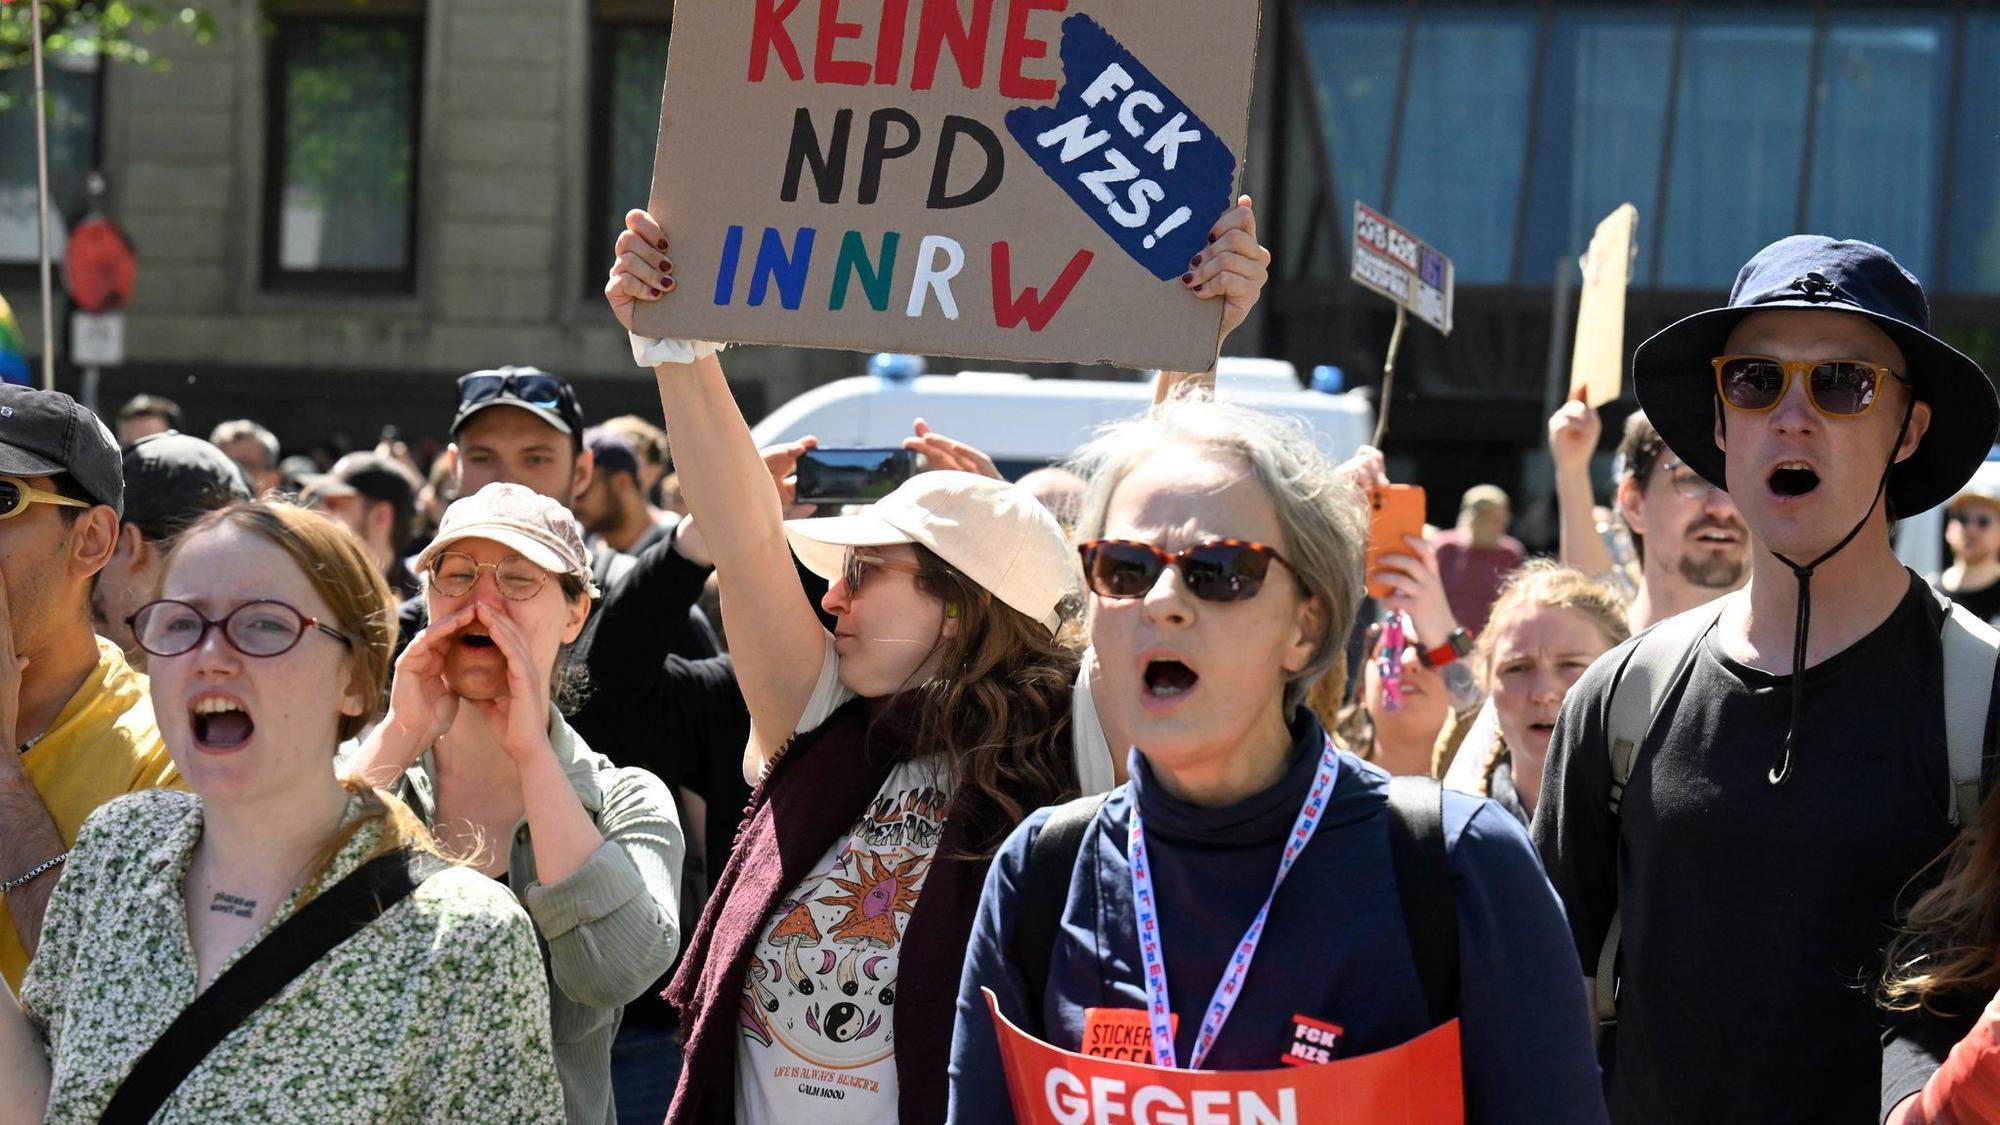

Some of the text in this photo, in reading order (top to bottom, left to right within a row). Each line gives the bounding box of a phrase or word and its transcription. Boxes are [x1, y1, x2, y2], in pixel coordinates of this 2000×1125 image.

[747, 0, 1069, 99] KEINE
[1082, 62, 1201, 171] FCK
[780, 107, 1005, 209] NPD
[1036, 114, 1193, 249] NZS!
[713, 224, 1094, 332] IN NRW
[1290, 1041, 1331, 1065] NZS
[1294, 1023, 1336, 1048] FCK
[798, 1083, 845, 1100] CALM MOOD
[800, 1067, 835, 1083] ALWAYS
[1045, 1067, 1299, 1125] GEGEN
